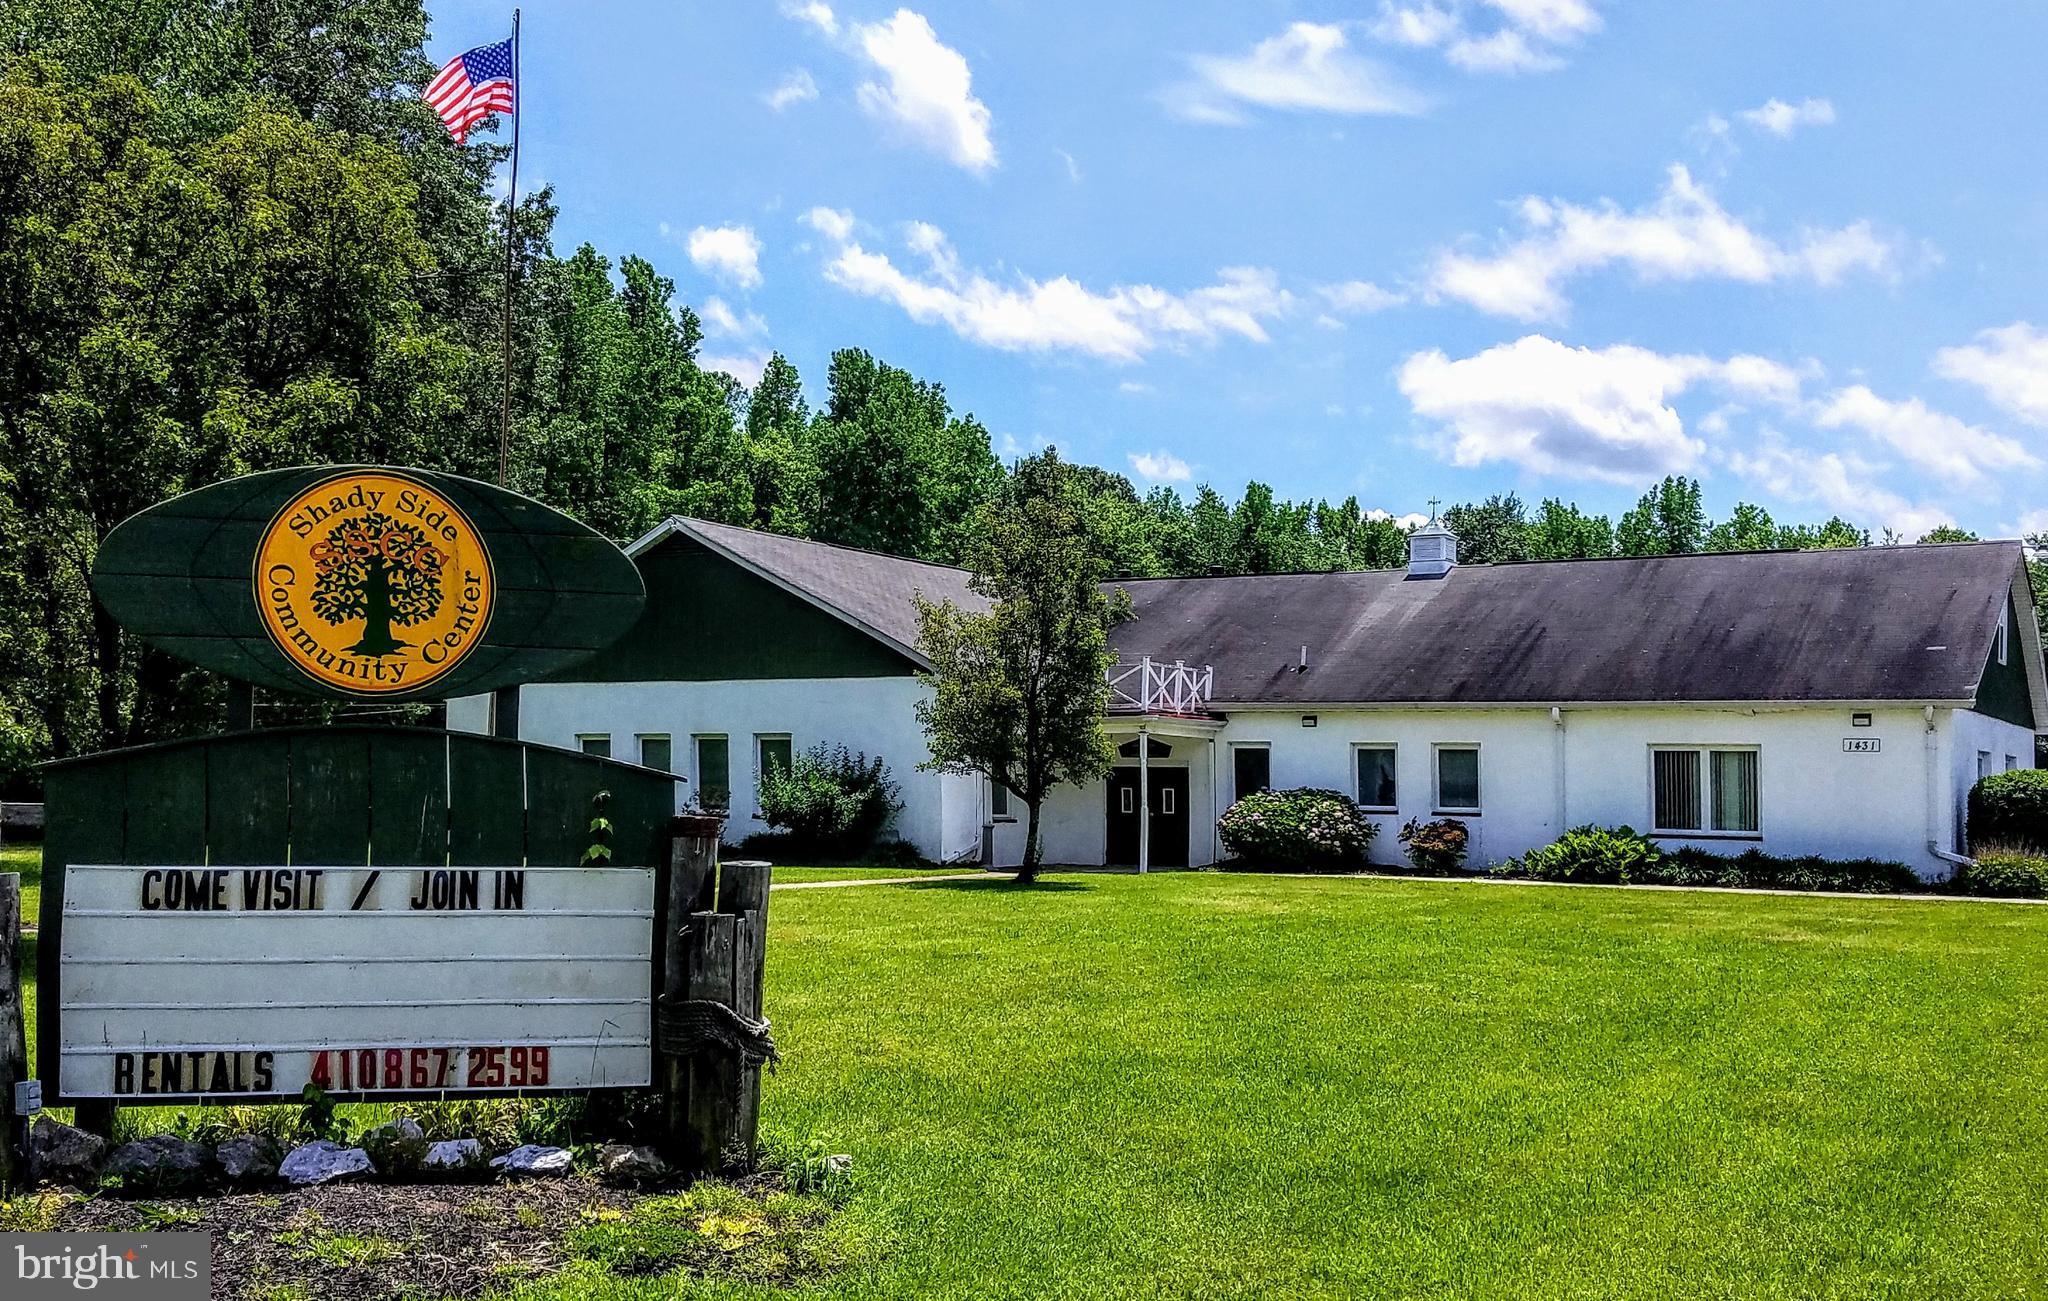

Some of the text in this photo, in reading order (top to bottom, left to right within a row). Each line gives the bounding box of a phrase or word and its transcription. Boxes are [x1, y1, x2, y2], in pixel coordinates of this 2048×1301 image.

[288, 485, 459, 542] Shady Side
[268, 564, 481, 684] Community Center
[1848, 741, 1875, 750] 1431
[141, 869, 228, 910] COME
[243, 869, 323, 910] VISIT
[411, 870, 479, 910] JOIN
[495, 870, 524, 909] IN
[115, 1051, 273, 1093] RENTALS
